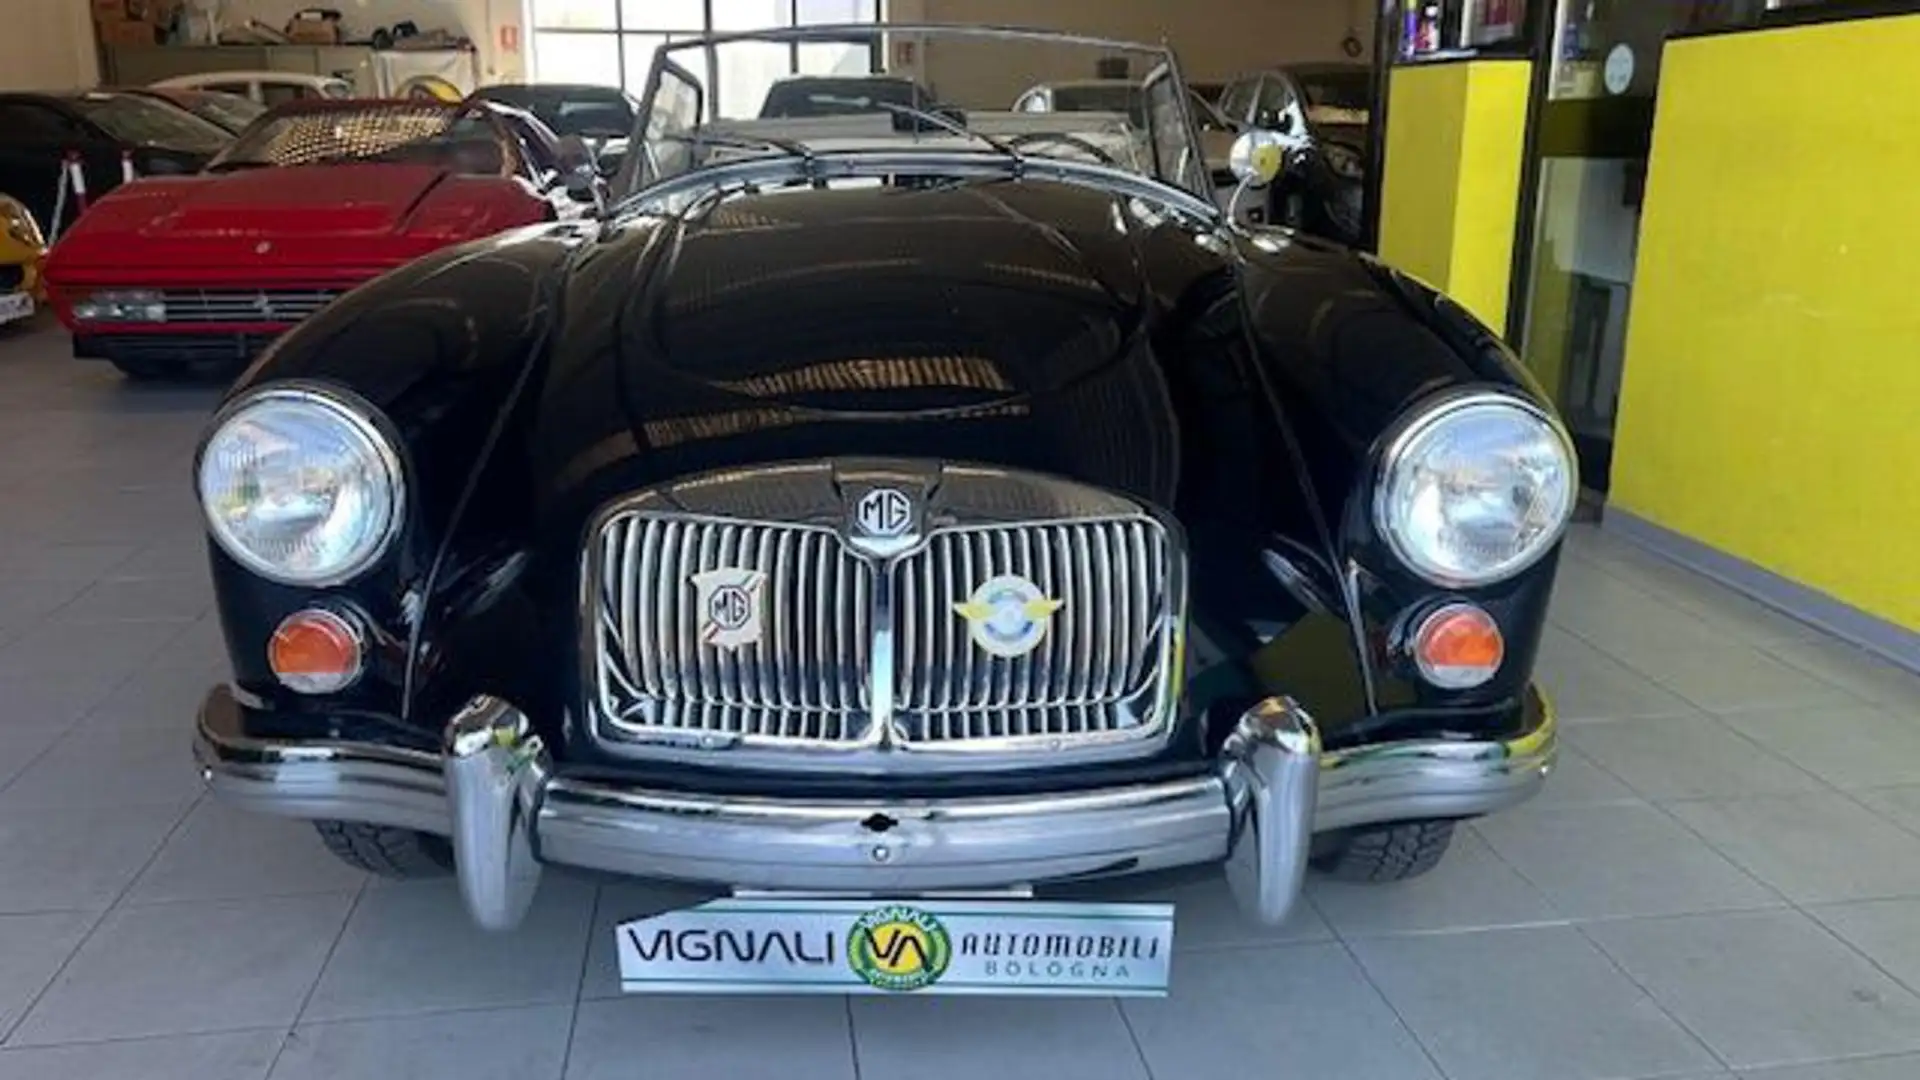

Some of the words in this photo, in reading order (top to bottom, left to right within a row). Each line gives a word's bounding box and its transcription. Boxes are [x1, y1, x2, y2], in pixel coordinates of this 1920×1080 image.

[863, 493, 906, 530] MG
[714, 590, 746, 622] MG
[627, 928, 834, 964] VIGNALI
[864, 927, 930, 971] VA
[961, 933, 1159, 959] AUTOMOBILI
[985, 960, 1130, 979] BOLOGNA
